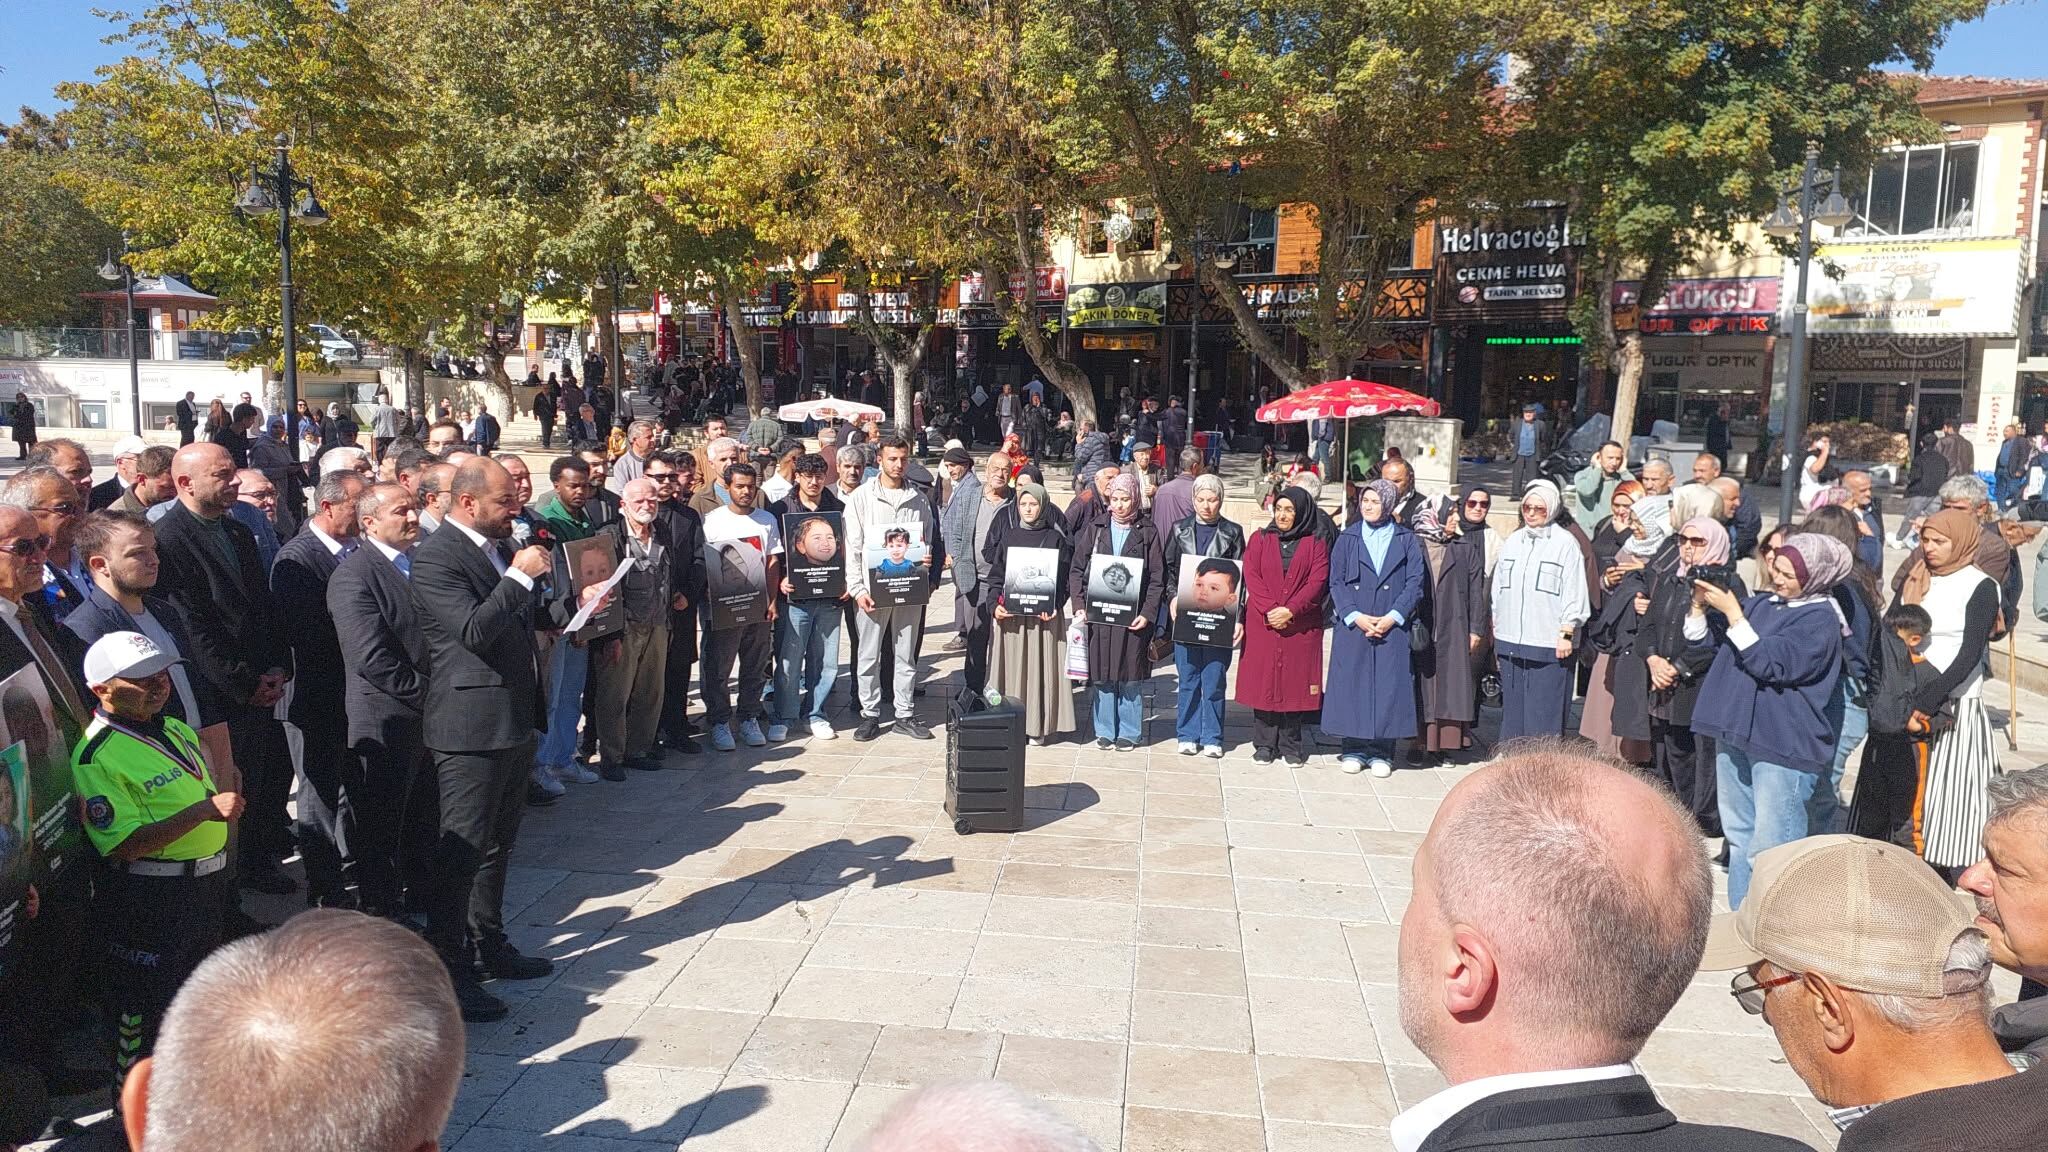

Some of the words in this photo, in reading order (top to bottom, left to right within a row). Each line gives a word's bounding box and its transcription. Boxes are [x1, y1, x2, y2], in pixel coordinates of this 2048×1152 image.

[1456, 266, 1511, 283] ÇEKME
[1516, 263, 1567, 279] HELVA
[796, 311, 806, 323] EL
[1082, 310, 1107, 321] AKIN
[1113, 309, 1150, 321] DÖNER
[1688, 316, 1769, 332] OPTİK
[143, 766, 183, 793] POLİS
